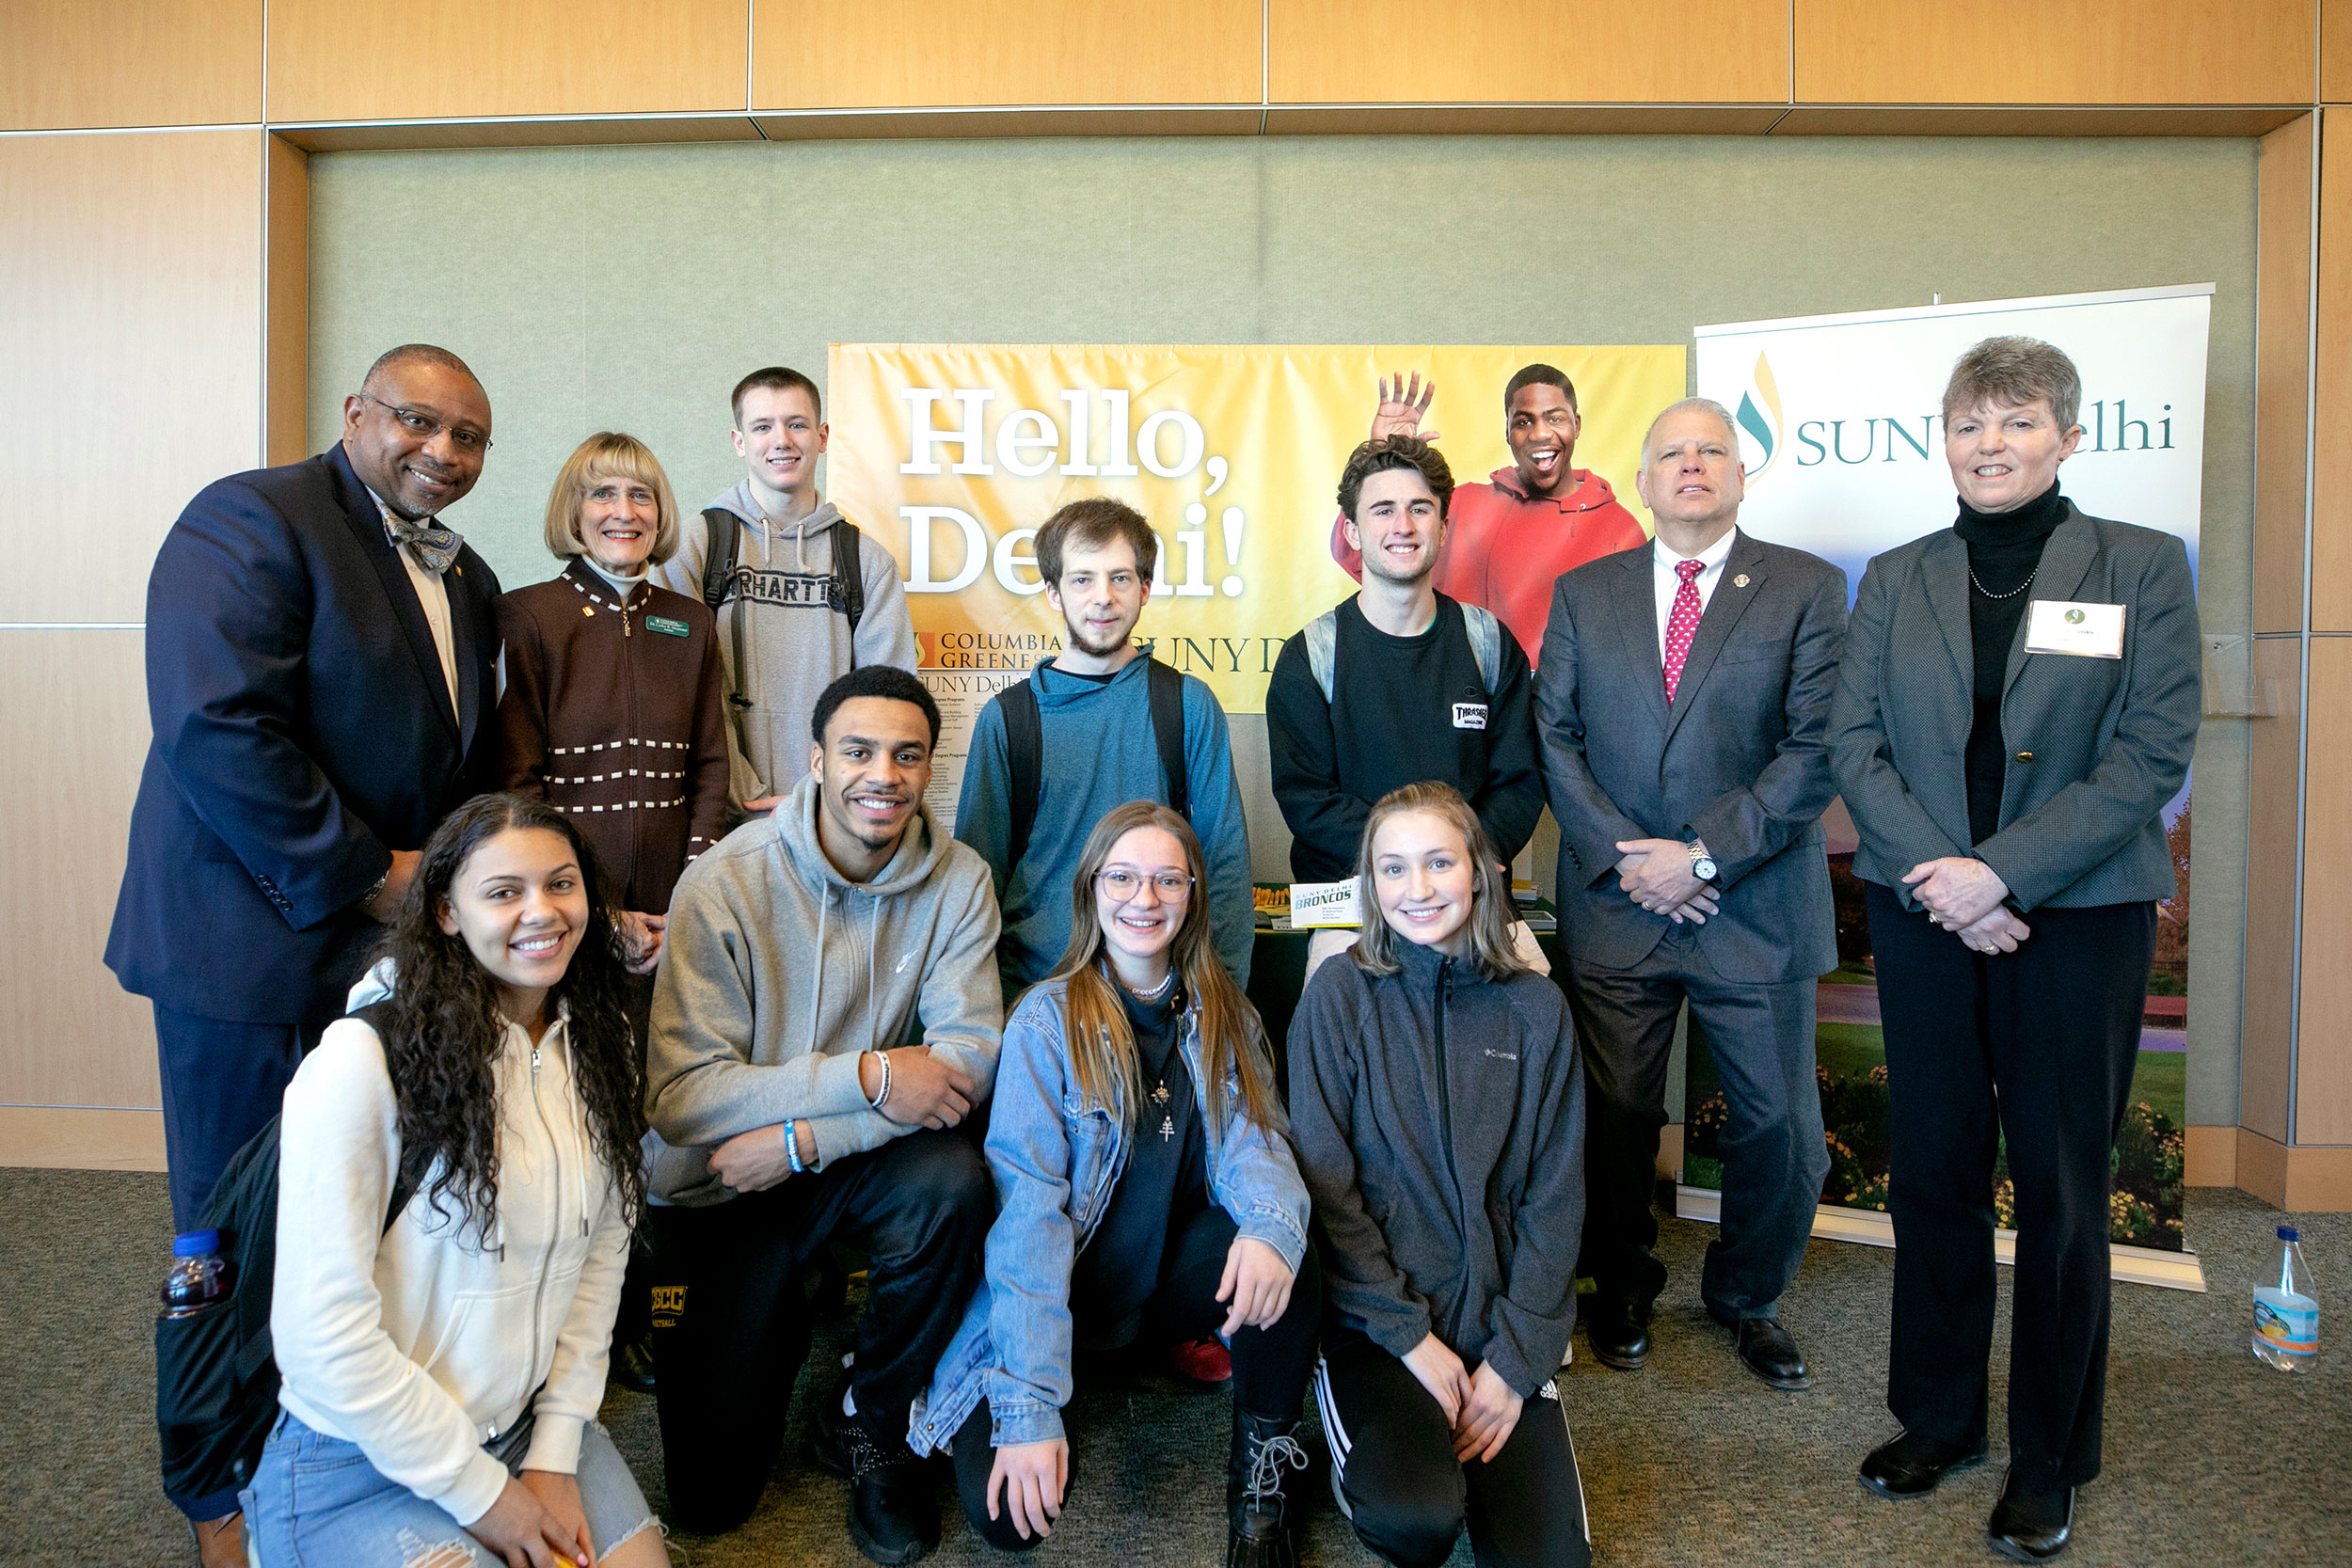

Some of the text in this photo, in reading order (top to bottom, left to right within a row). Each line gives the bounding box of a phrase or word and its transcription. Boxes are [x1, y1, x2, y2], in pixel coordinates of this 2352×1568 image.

[899, 388, 1229, 497] Hello,
[1797, 415, 1944, 466] SUN
[899, 502, 1245, 597] Dei!
[941, 632, 1062, 651] COLUMBIA
[941, 652, 1030, 669] GREENE
[919, 675, 971, 693] UNY
[1295, 890, 1352, 910] BRONCOS
